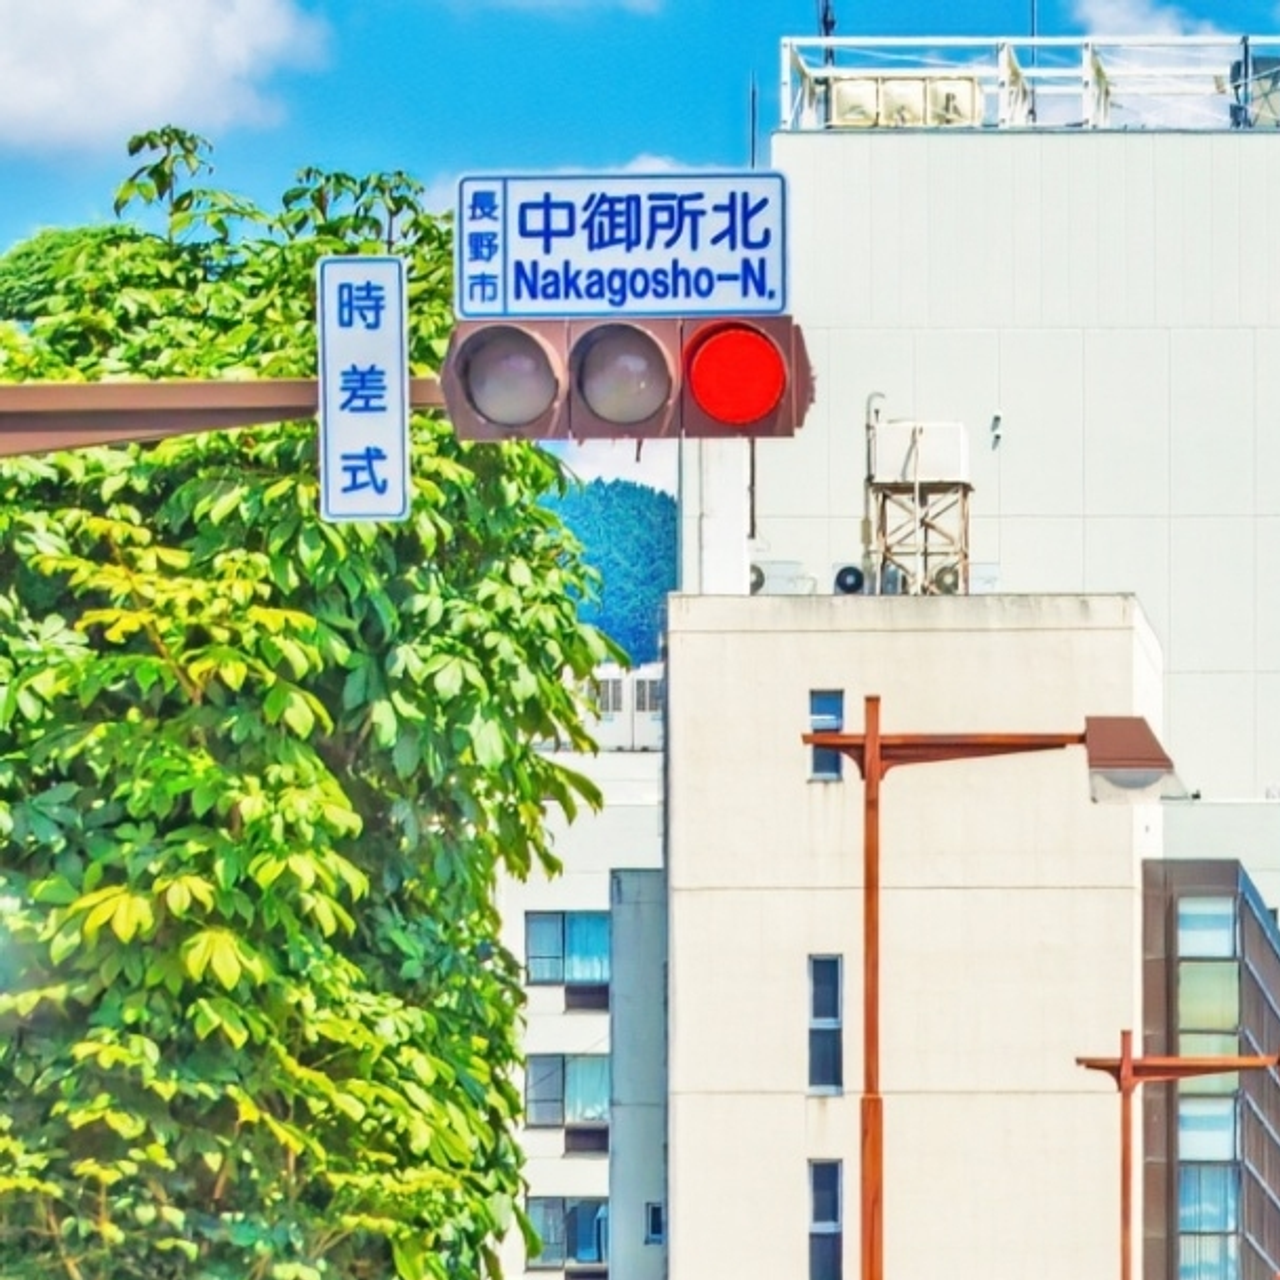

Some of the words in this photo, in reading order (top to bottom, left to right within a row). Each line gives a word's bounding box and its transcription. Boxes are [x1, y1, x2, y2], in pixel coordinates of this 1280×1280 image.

[467, 190, 500, 303] 長野市
[517, 191, 773, 256] 中御所北
[513, 258, 776, 308] Nakagosho-N.
[337, 280, 389, 496] 時差式
